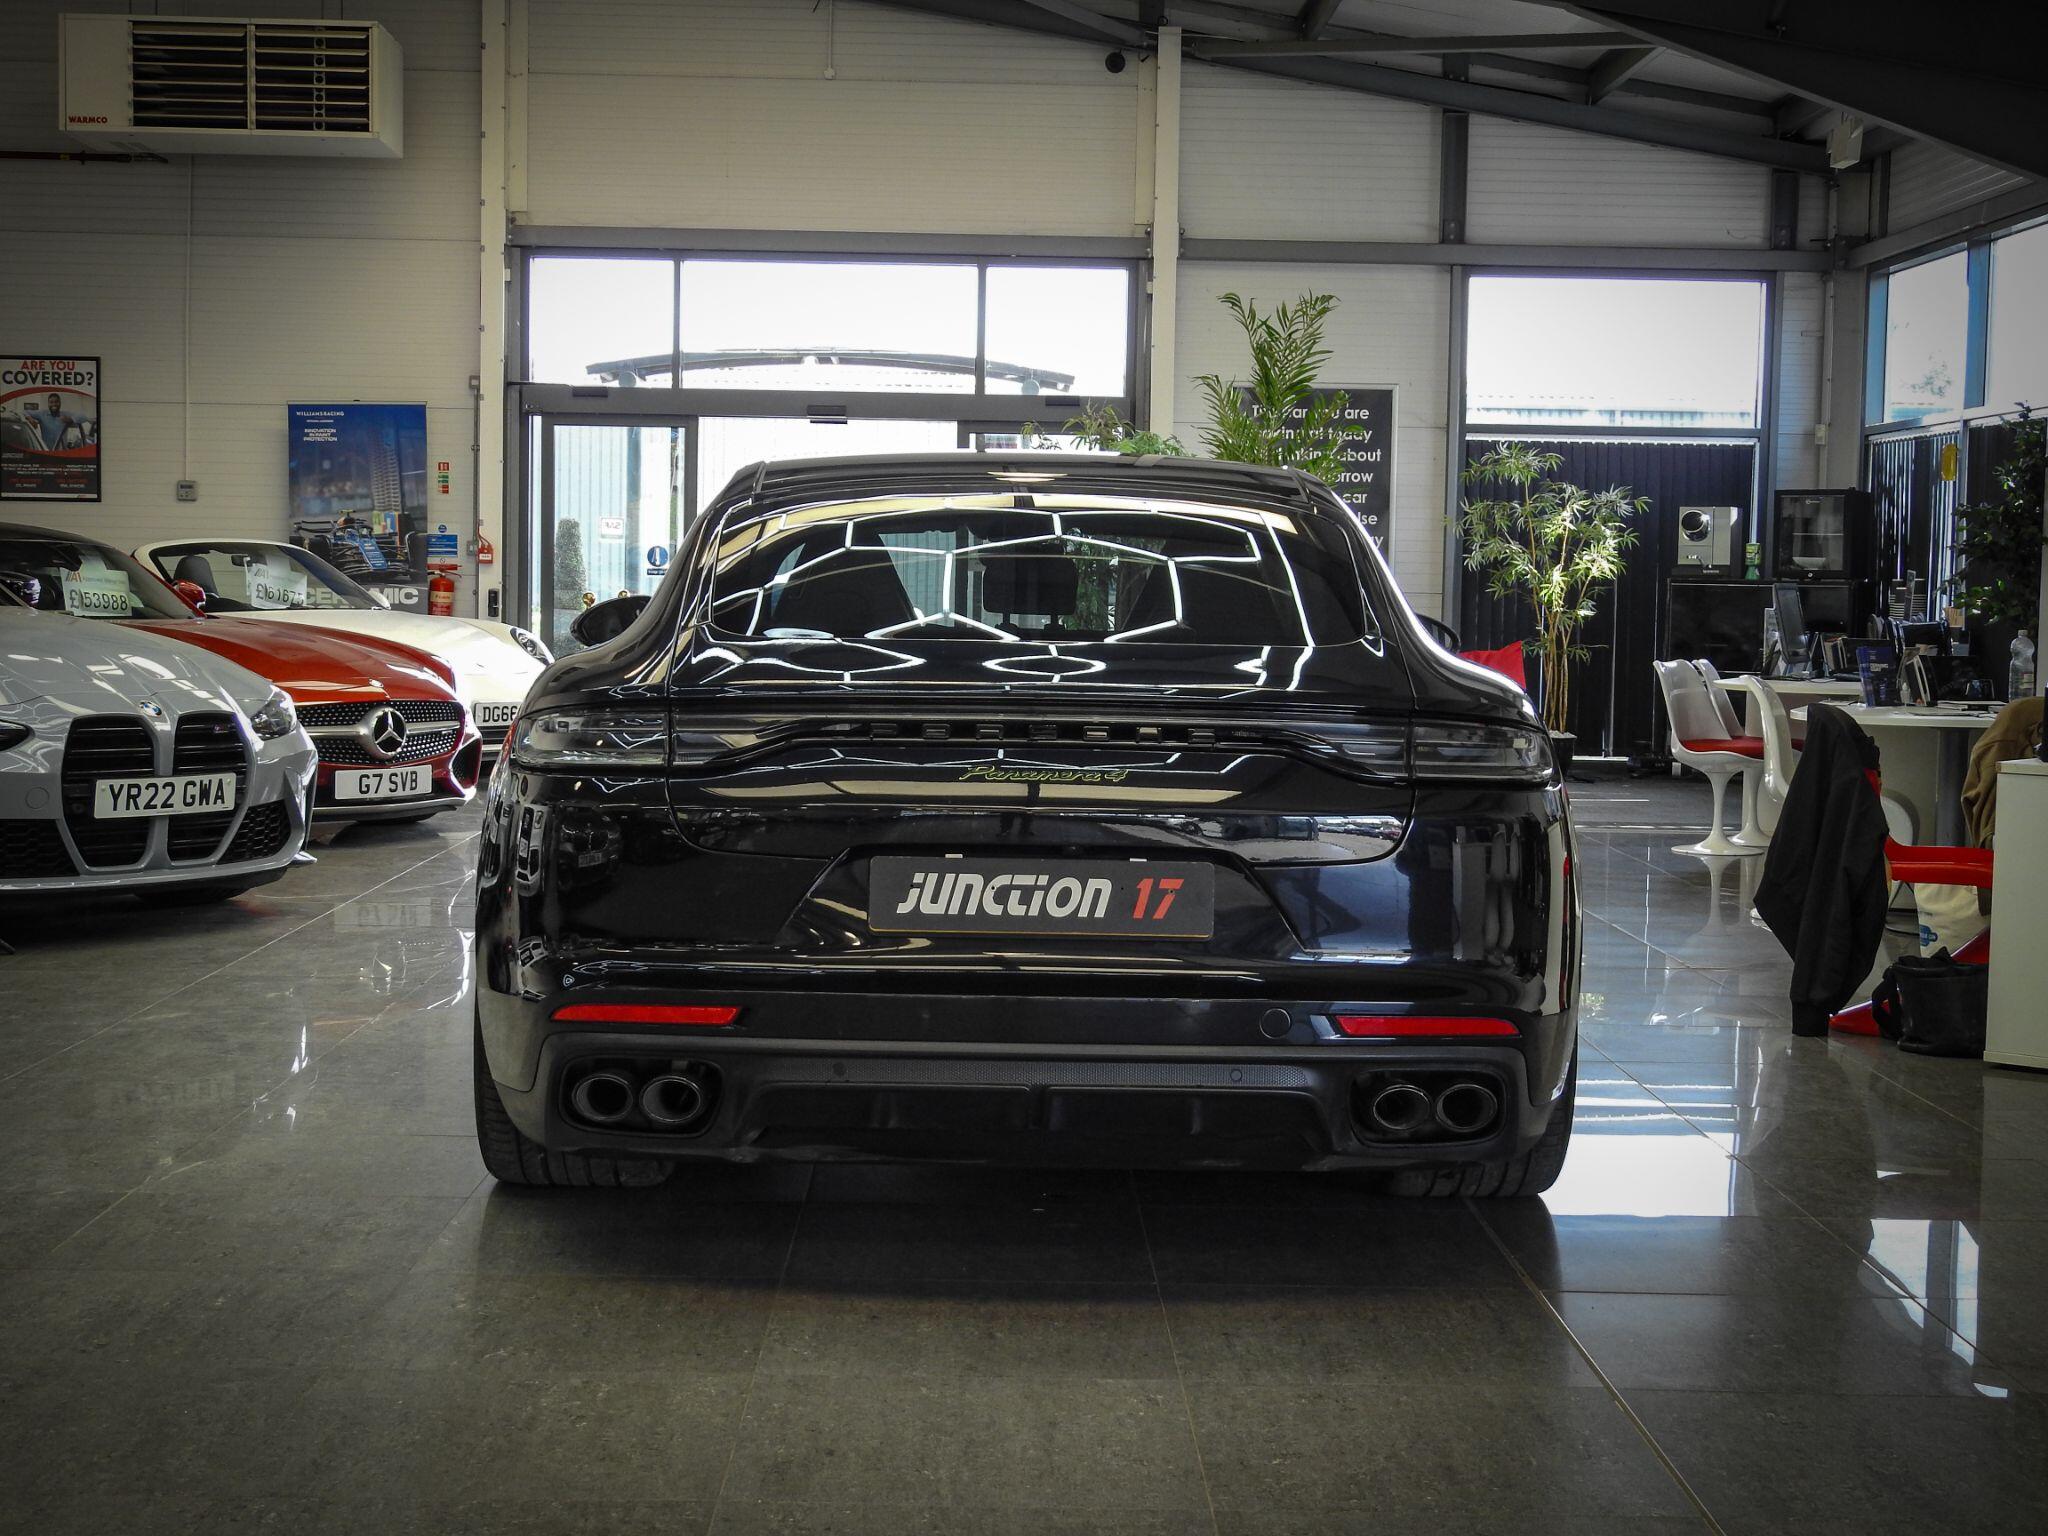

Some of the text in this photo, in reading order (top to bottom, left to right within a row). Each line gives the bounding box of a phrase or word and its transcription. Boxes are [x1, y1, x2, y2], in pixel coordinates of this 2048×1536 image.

[68, 115, 109, 124] WARMCO
[21, 361, 76, 371] ARE YOU
[2, 370, 95, 386] COVERED?
[1344, 408, 1370, 420] are
[1337, 448, 1382, 462] about
[1342, 493, 1368, 504] car
[1357, 511, 1378, 525] lse
[959, 765, 1100, 782] Panamera
[358, 770, 419, 795] G7 SVB
[108, 778, 227, 812] YR22 GWA
[1130, 876, 1186, 921] 17
